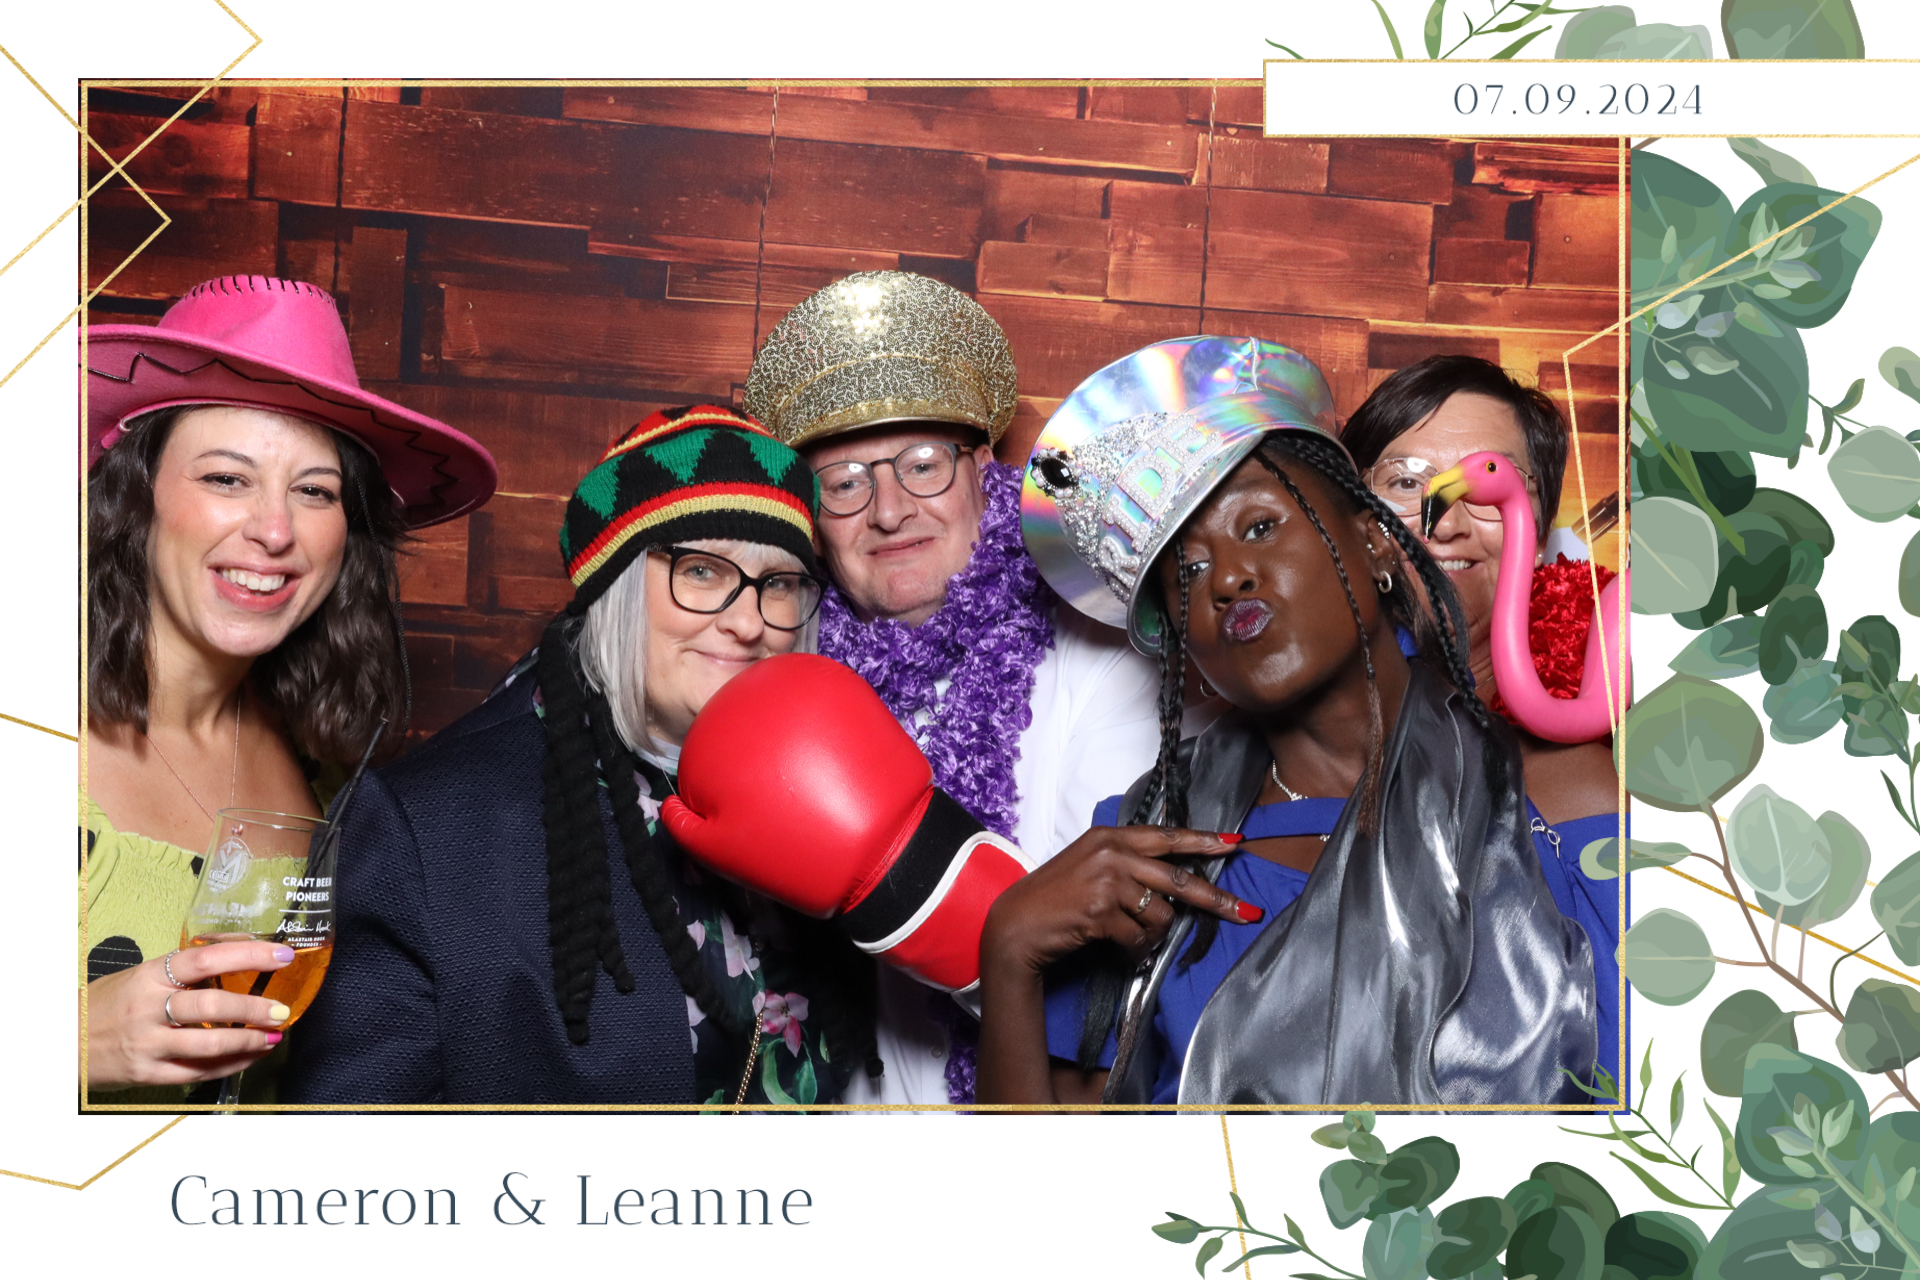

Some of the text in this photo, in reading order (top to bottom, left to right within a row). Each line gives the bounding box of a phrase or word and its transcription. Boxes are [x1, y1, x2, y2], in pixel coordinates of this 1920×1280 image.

[1099, 411, 1224, 603] RIDE
[282, 876, 332, 888] CRAFT BEER
[285, 891, 330, 902] PIONEERS
